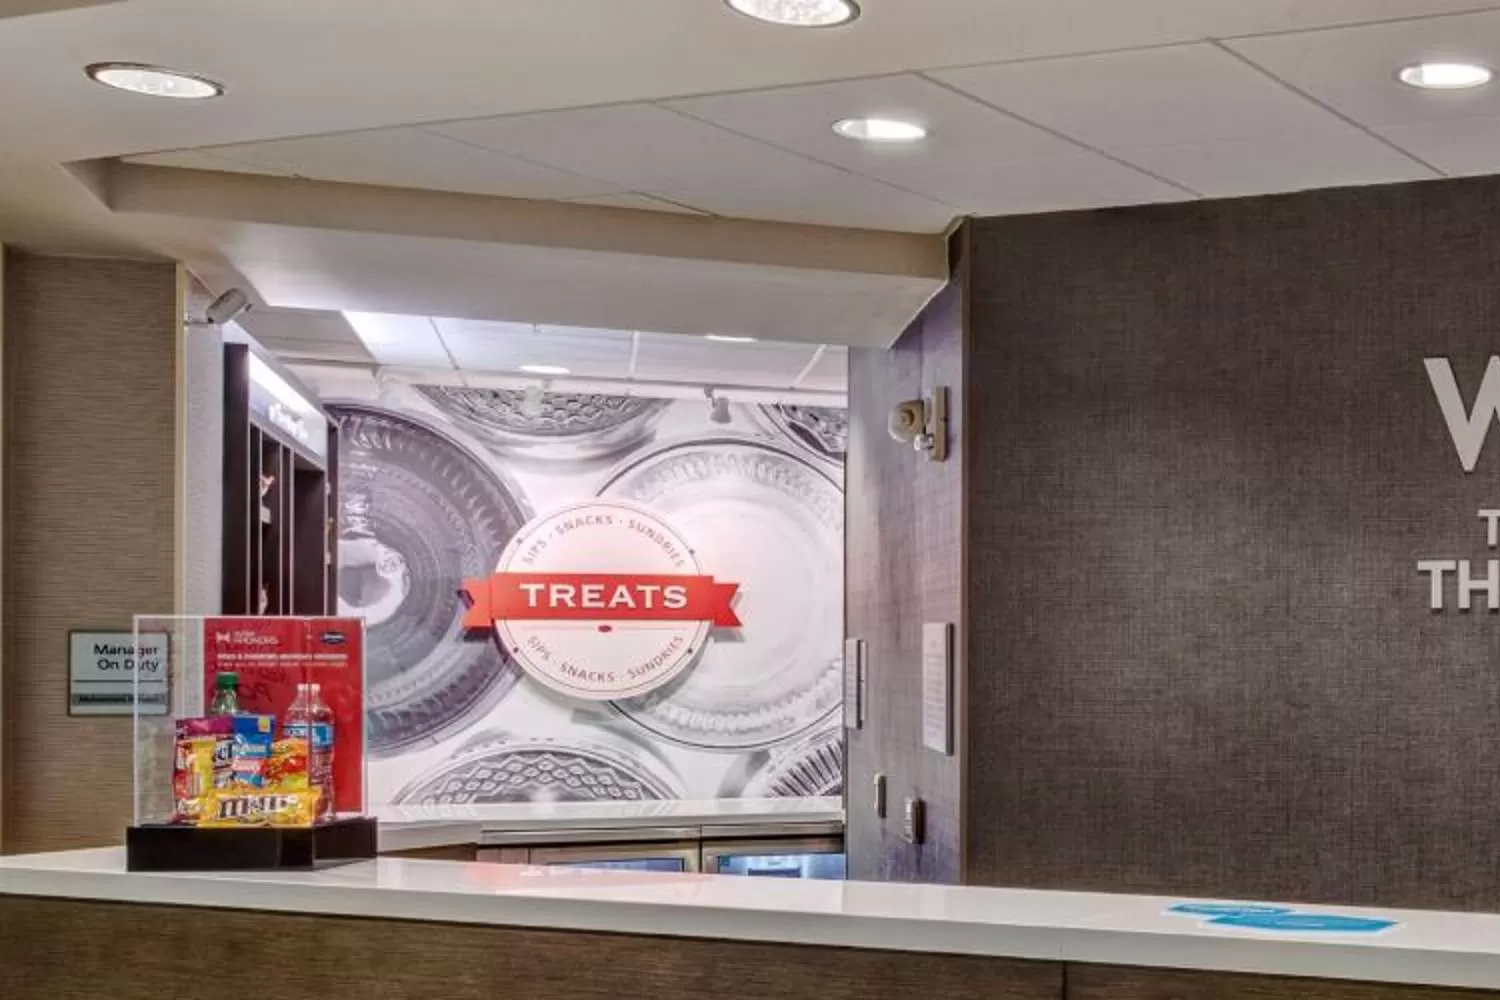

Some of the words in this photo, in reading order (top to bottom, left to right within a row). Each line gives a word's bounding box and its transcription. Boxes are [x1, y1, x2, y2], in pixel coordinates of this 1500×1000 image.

[555, 514, 614, 535] SNACKS
[628, 519, 685, 568] SUNDRIES
[519, 583, 688, 609] TREATS
[93, 643, 159, 657] Manager
[560, 660, 616, 682] SNACKS
[627, 635, 685, 679] SUNDRIES
[97, 659, 119, 671] On
[124, 659, 159, 673] Duty
